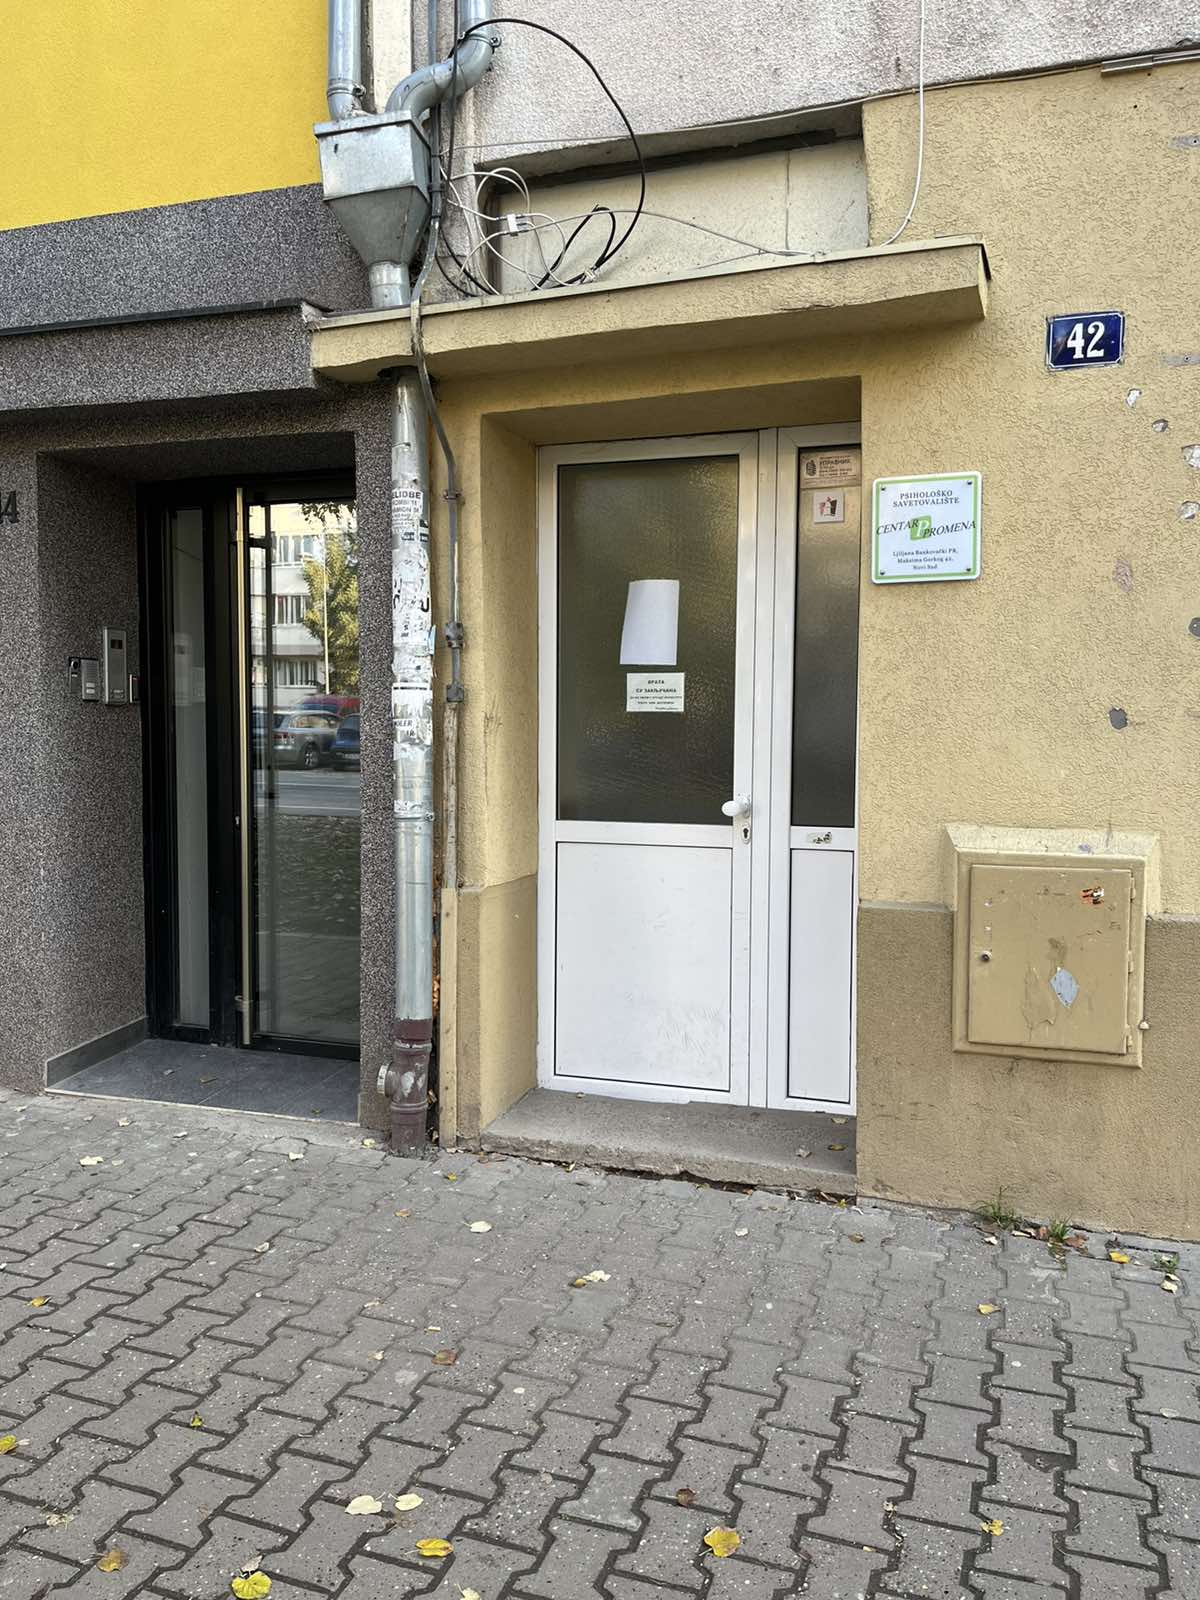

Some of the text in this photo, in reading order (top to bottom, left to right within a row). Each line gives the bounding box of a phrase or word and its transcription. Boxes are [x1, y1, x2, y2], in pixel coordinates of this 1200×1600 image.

[1066, 321, 1105, 359] 42
[892, 497, 960, 508] SAVETOVALIŠTE
[899, 489, 953, 500] PSIHOLOŠKO
[876, 518, 977, 539] CENTAR PROMENA
